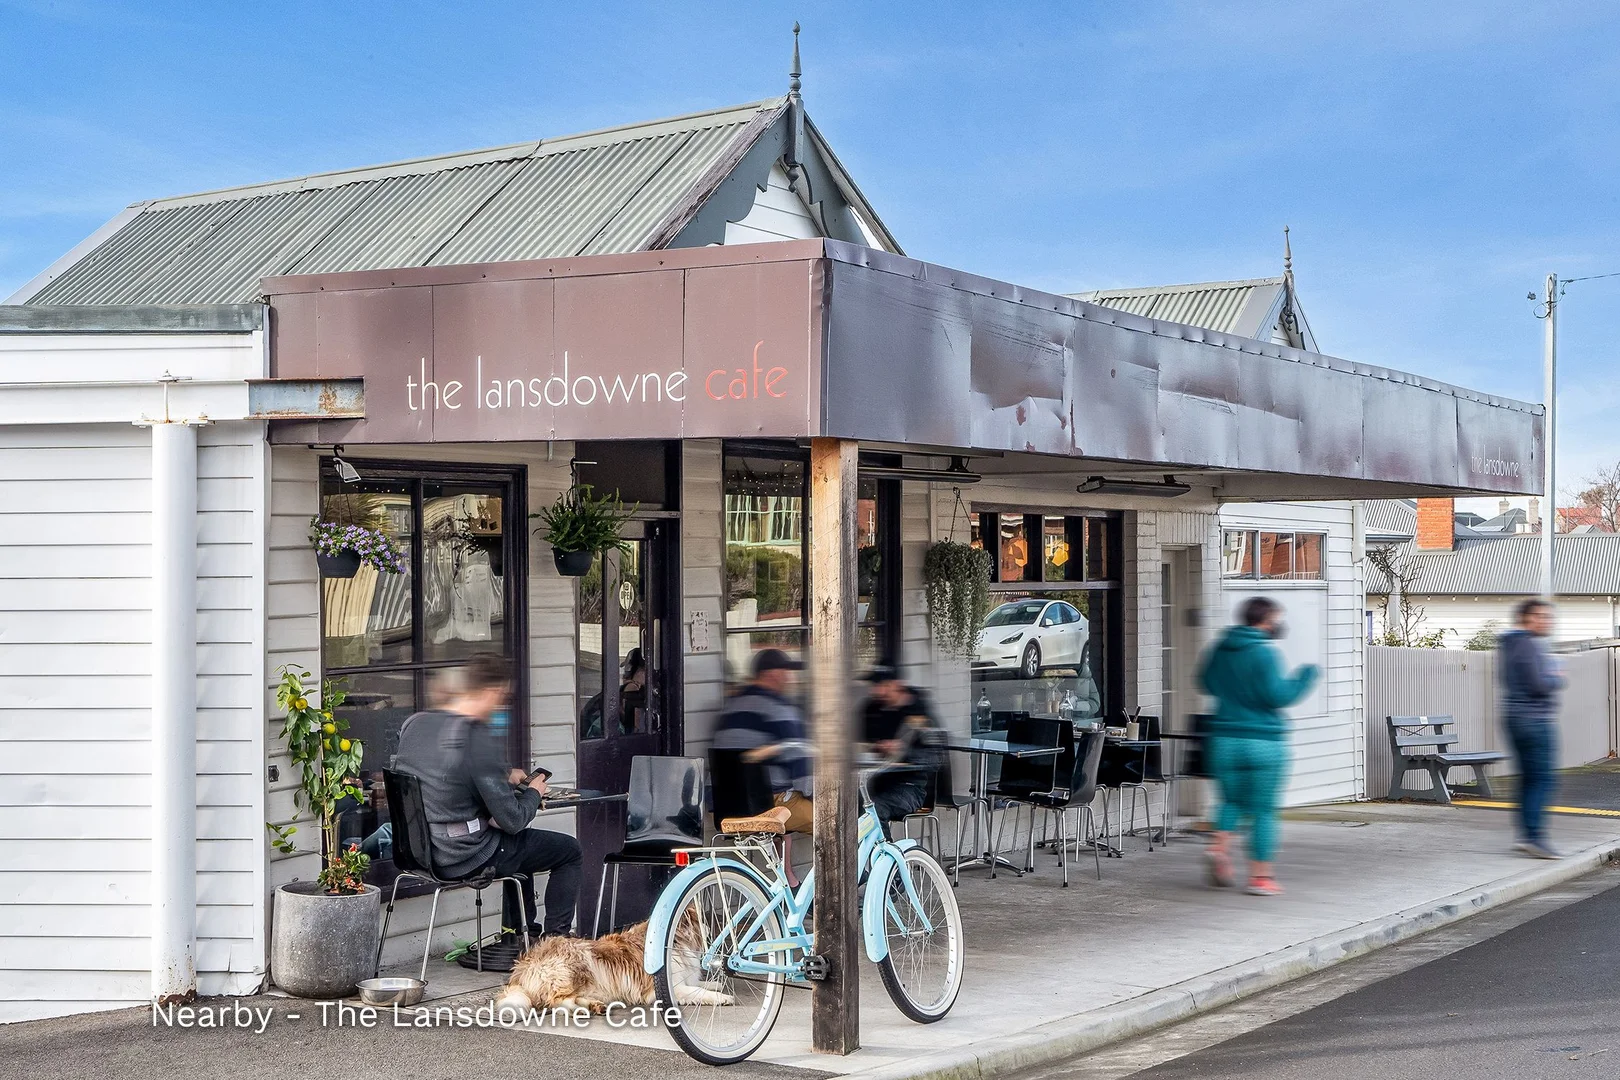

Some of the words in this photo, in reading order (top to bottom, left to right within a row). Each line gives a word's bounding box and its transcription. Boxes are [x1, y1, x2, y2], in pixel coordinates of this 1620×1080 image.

[407, 357, 463, 411] the
[477, 351, 688, 410] lansdowne
[705, 340, 789, 401] cafe
[1483, 444, 1519, 478] lansdowne
